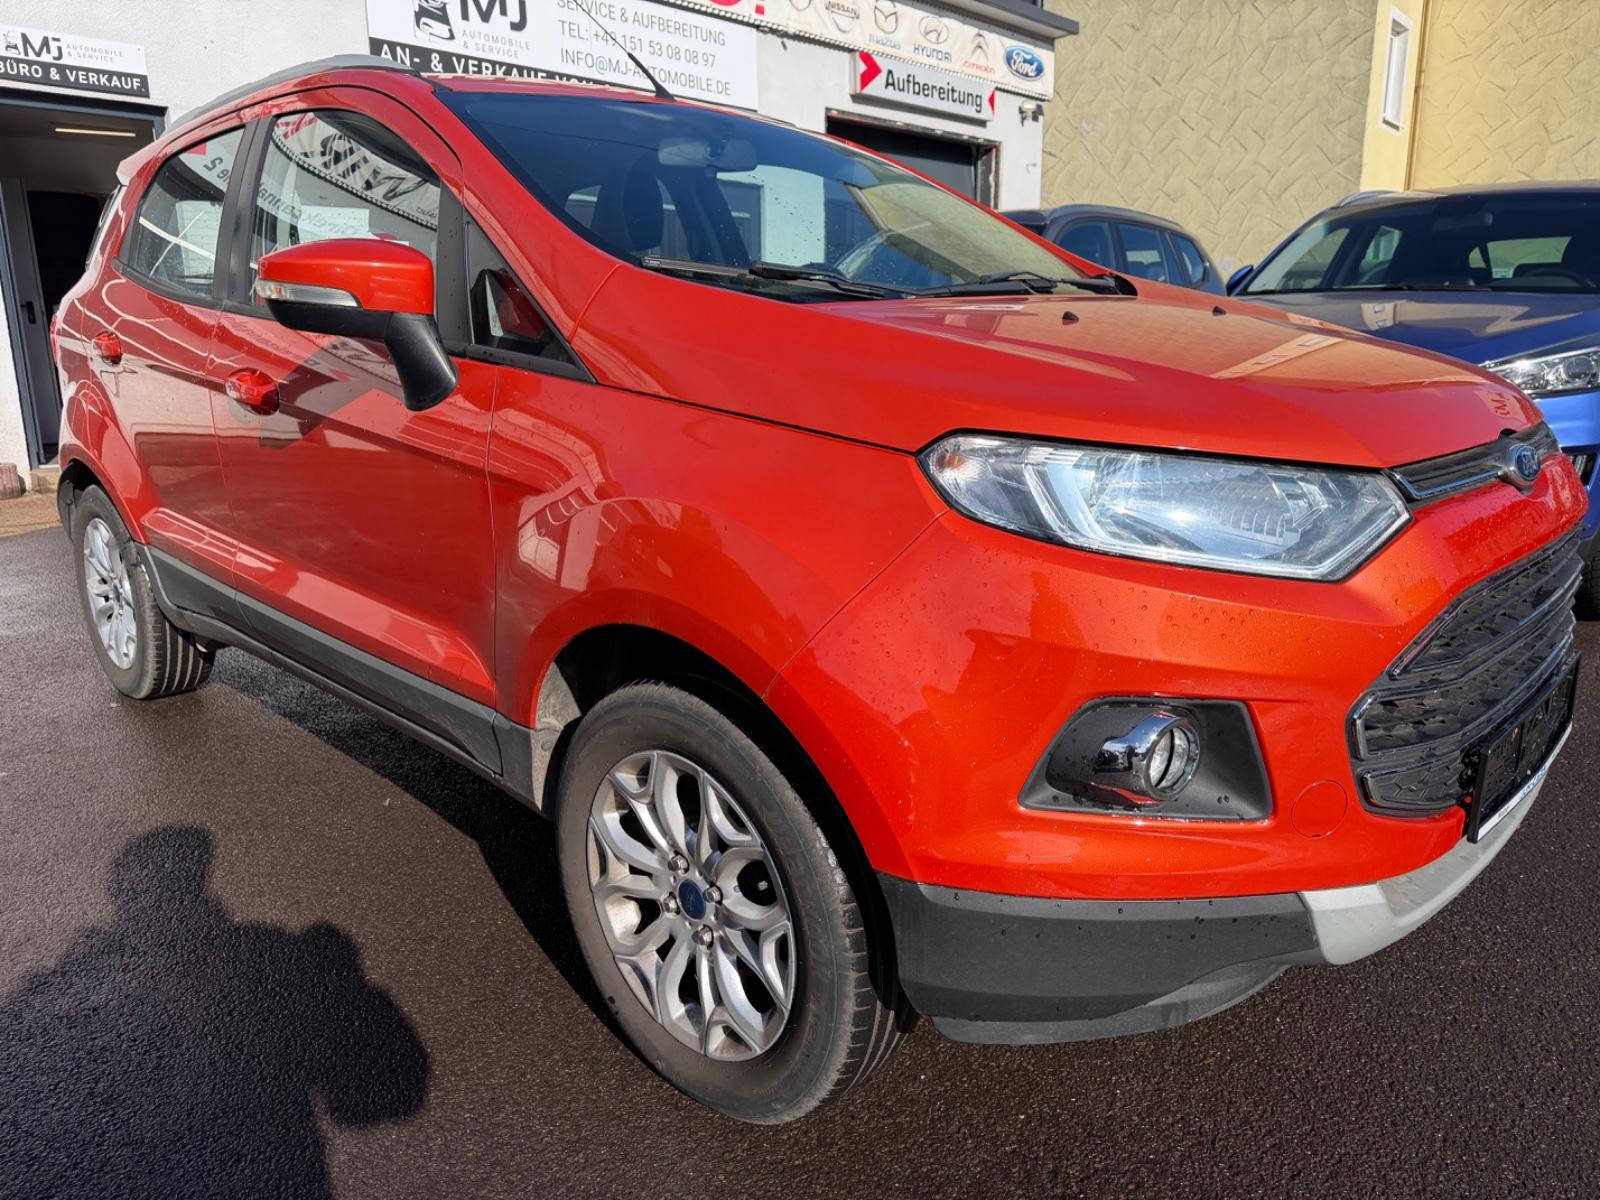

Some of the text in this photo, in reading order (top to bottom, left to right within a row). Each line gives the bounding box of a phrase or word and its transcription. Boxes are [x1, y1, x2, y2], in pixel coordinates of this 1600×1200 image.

[825, 1, 857, 16] NISSAN
[557, 0, 726, 46] SERVICE & AUFBEREITUNG
[20, 32, 63, 61] MJ
[66, 43, 124, 57] AUTOMOBILE
[462, 29, 530, 50] AUTOMOBILE
[474, 43, 519, 59] SERVICE
[558, 19, 716, 68] TEL: +49 151 53 08 08 97
[77, 52, 114, 64] SERVICE
[380, 43, 420, 67] AN-
[431, 52, 443, 73] &
[913, 43, 952, 62] HYUNDAI
[1010, 51, 1039, 77] Ford
[50, 67, 60, 80] &
[65, 69, 146, 92] VERKAUF.
[560, 48, 731, 96] INFO@MJ-AUTOMOBILE.DE
[884, 69, 983, 113] Aufbereitung
